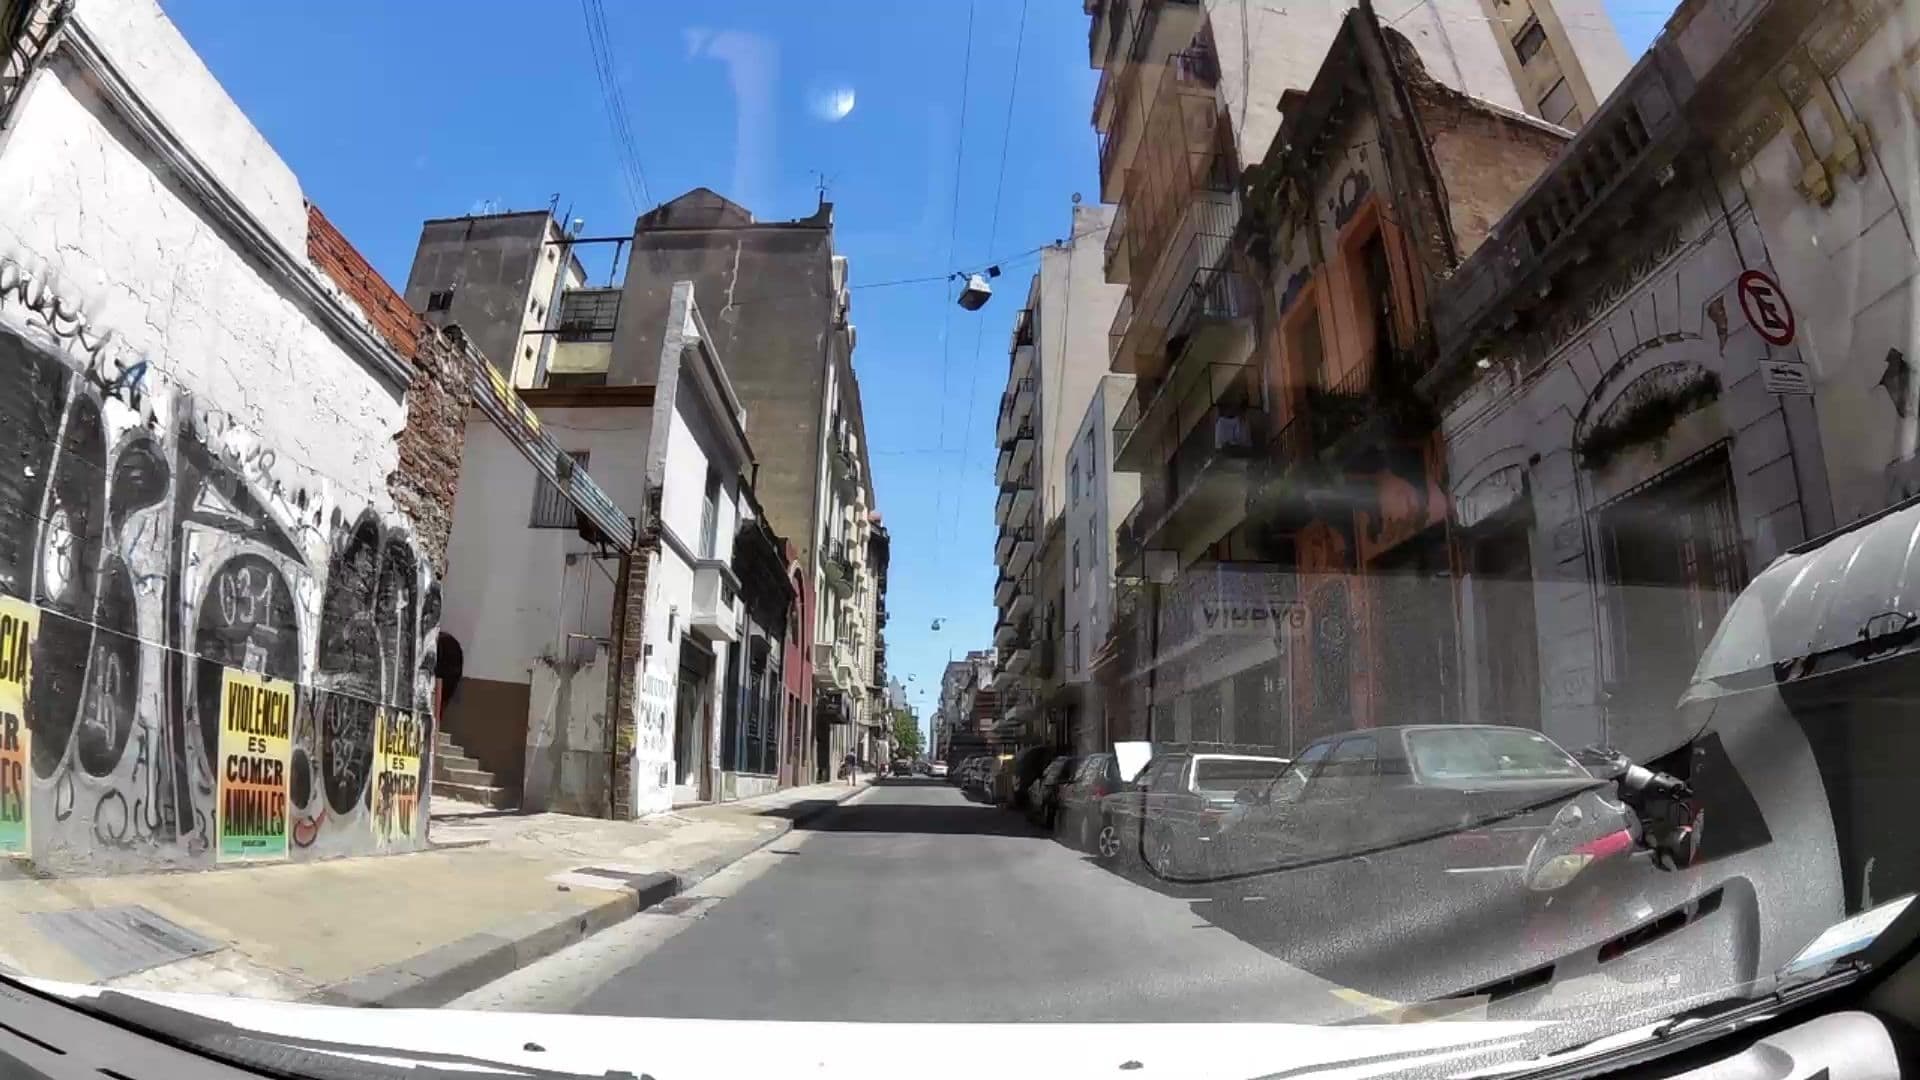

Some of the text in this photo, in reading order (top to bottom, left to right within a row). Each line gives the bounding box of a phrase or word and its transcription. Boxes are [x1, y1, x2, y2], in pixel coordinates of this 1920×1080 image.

[228, 681, 289, 739] VIOLENCIA
[248, 737, 266, 753] ES
[226, 754, 284, 786] COMER
[392, 757, 405, 770] ES
[224, 788, 285, 836] ANIMALES
